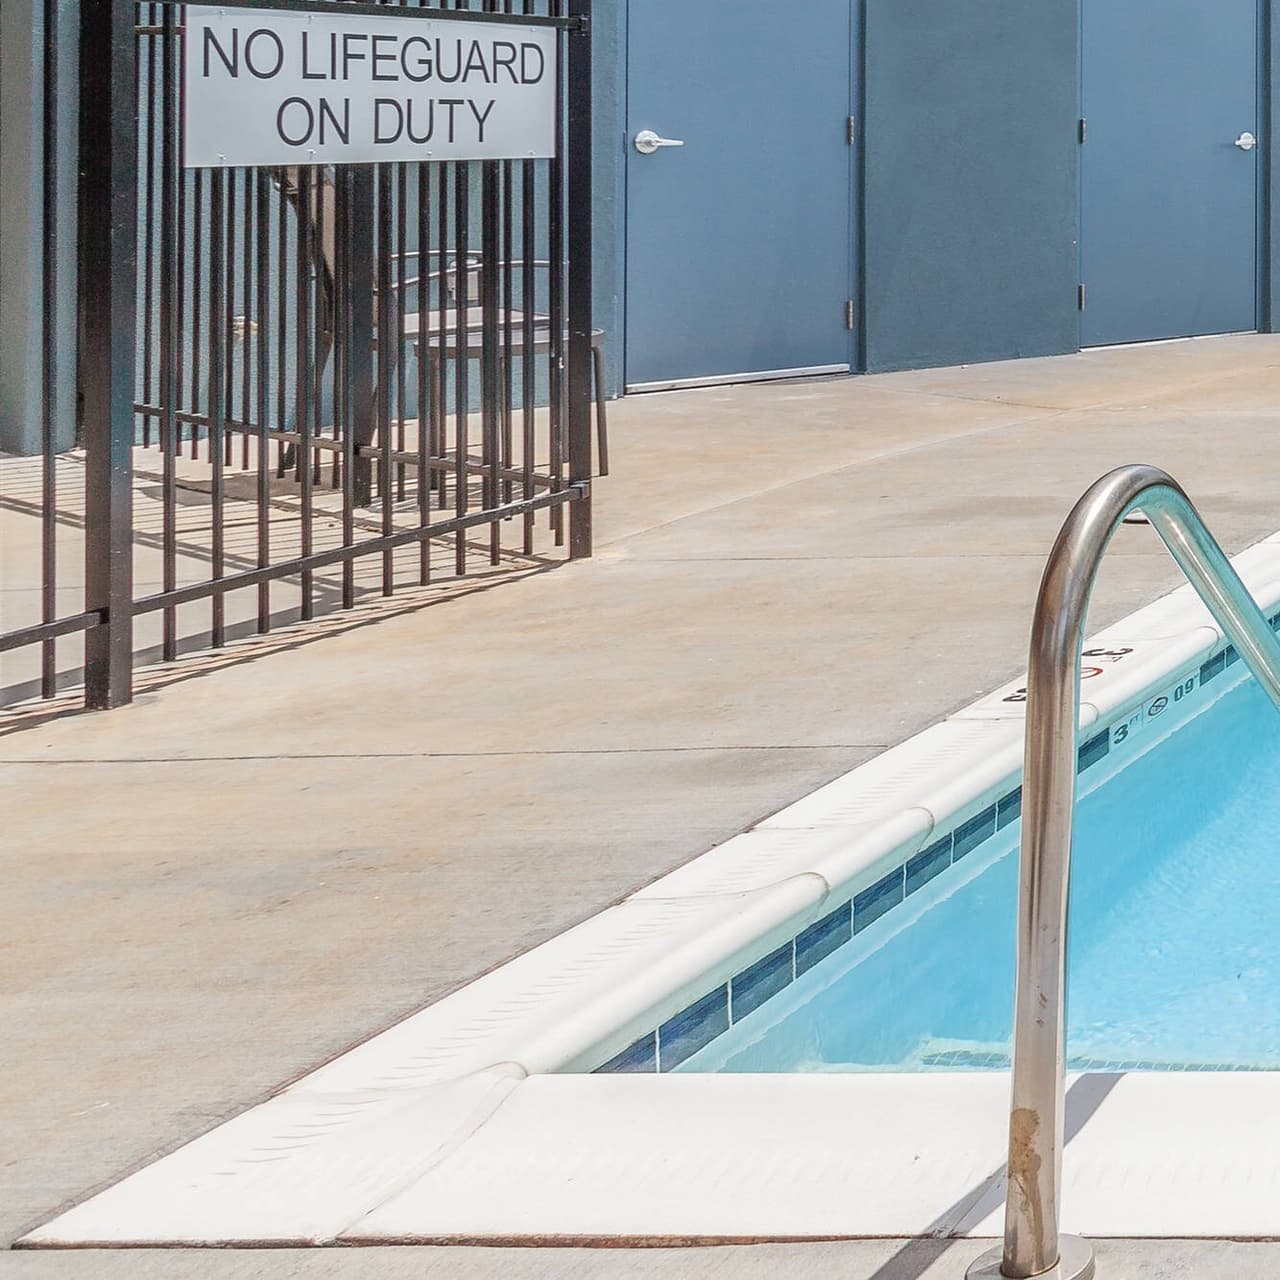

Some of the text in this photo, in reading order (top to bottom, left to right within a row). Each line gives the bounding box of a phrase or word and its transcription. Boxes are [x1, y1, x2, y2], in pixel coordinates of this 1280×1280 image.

[202, 26, 545, 86] NO LIFEGUARD
[276, 96, 496, 146] ON DUTY
